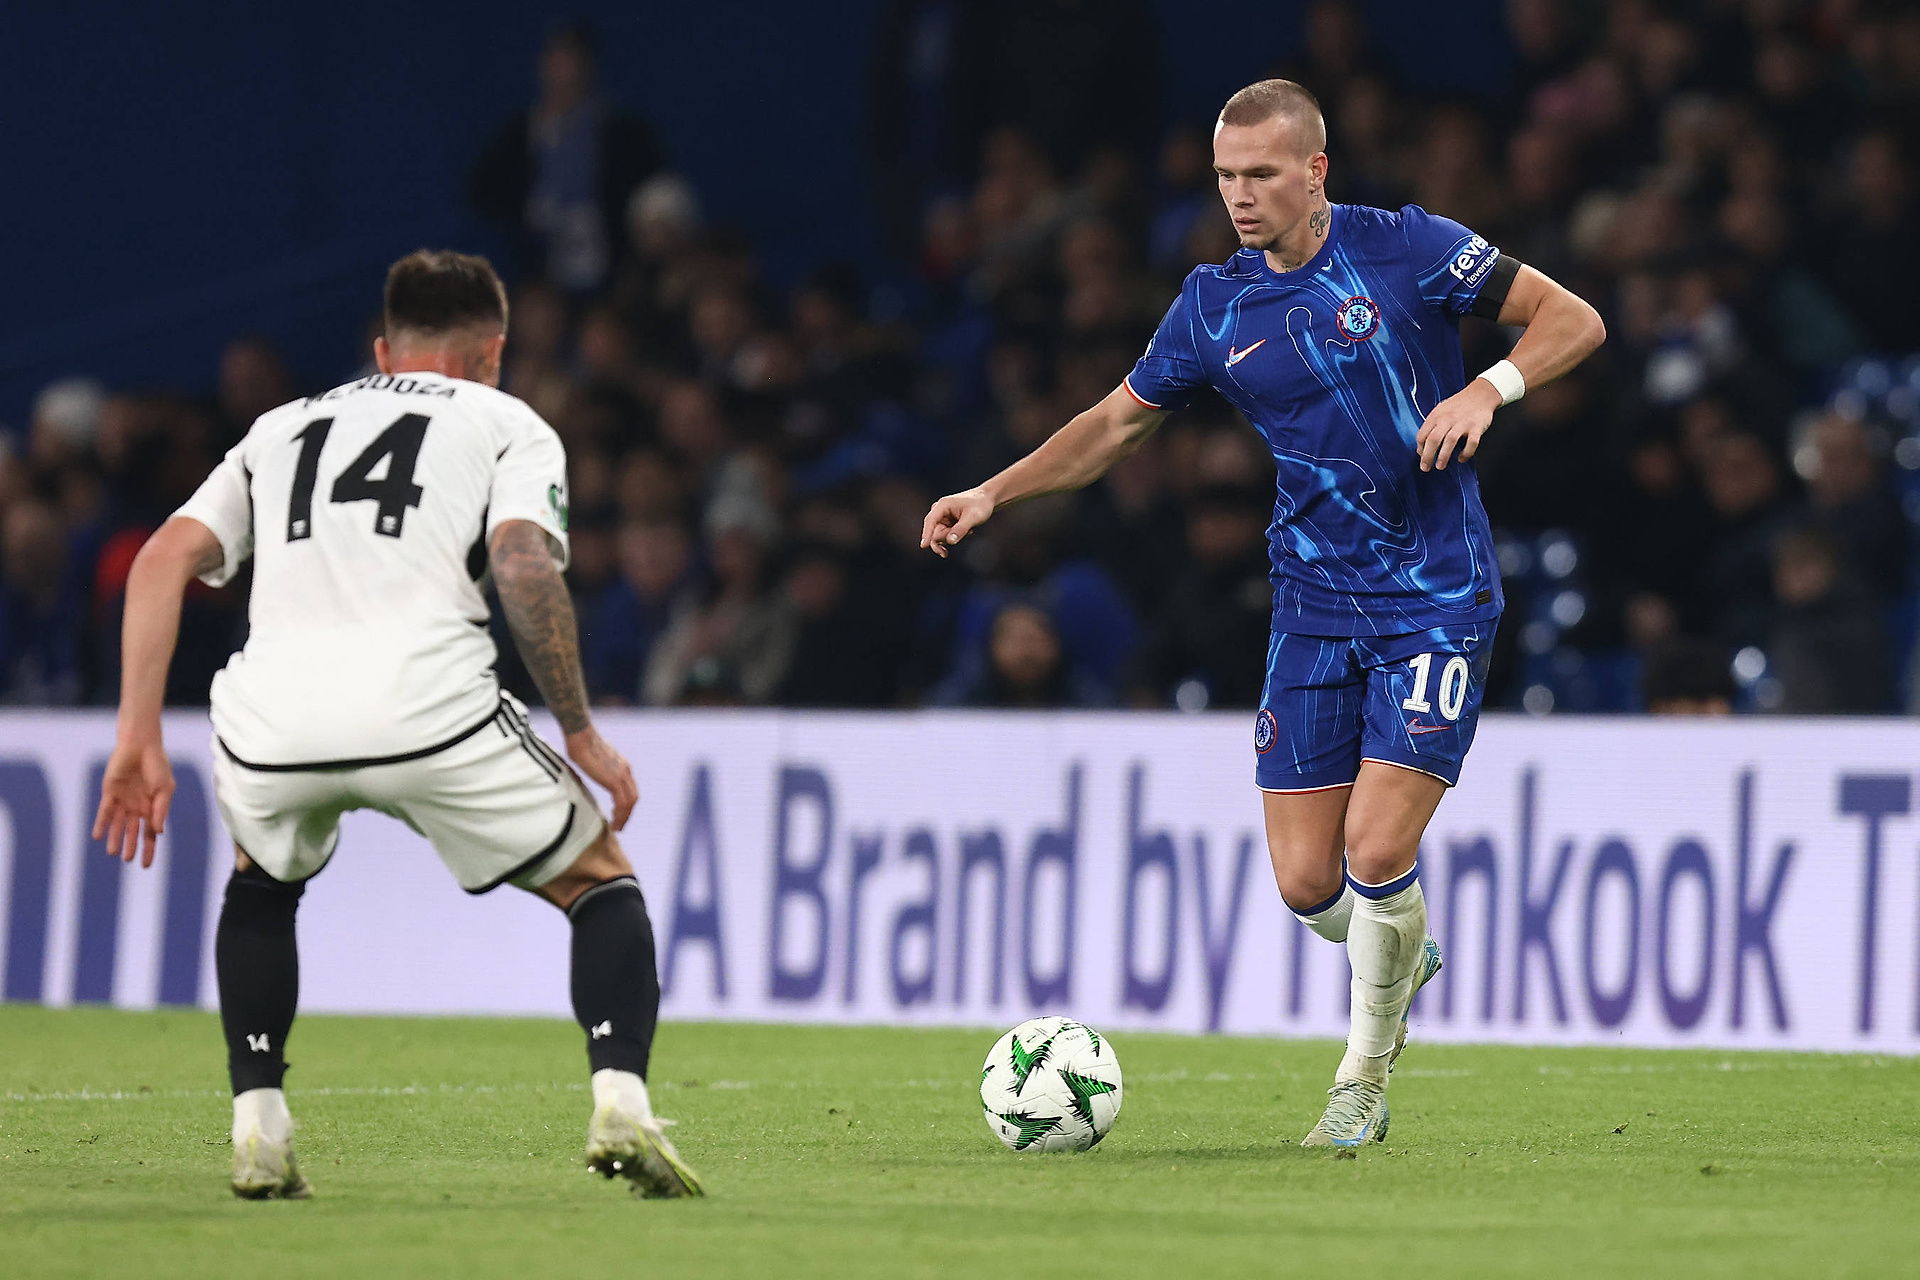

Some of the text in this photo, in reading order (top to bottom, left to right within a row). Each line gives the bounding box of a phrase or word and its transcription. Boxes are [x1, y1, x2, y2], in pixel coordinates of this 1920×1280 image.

[1449, 235, 1489, 280] feve
[286, 412, 431, 543] 14
[1402, 653, 1469, 721] 10
[661, 760, 728, 1000] A
[768, 758, 1083, 1010] Brand
[1118, 758, 1255, 1034] by
[246, 1033, 271, 1053] 14
[591, 1020, 613, 1041] 14
